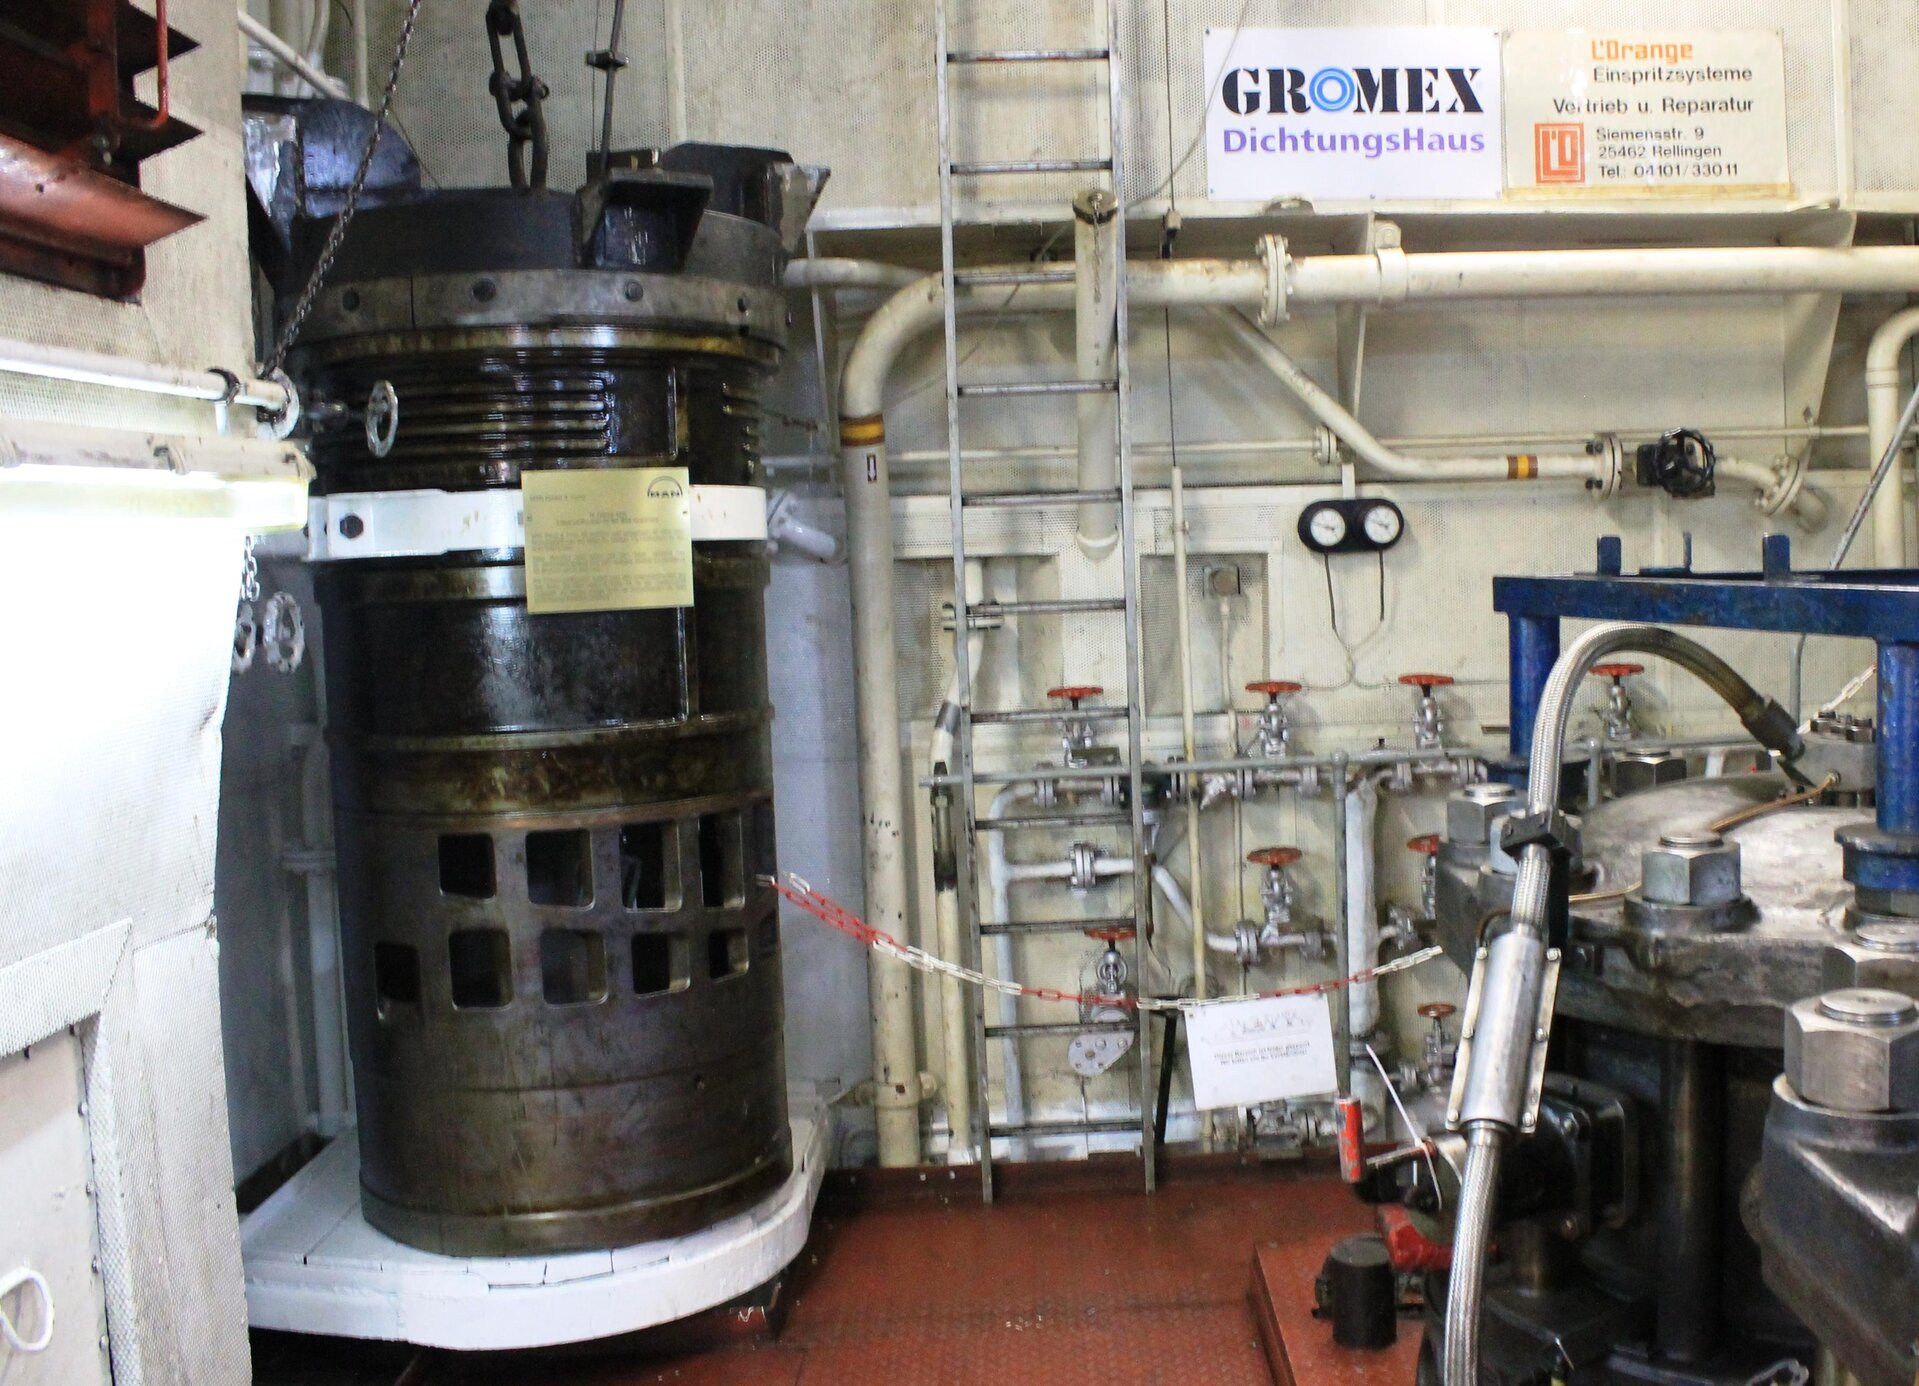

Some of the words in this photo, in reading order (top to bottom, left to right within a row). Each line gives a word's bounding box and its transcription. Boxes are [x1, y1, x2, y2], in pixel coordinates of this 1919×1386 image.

[1591, 39, 1693, 64] L'Orange
[1593, 65, 1753, 85] Einspritzsysteme
[1222, 67, 1484, 115] GROMEX
[1553, 97, 1628, 114] Vertrieb
[1662, 96, 1754, 116] Reparatur
[1223, 127, 1485, 158] DichtungsHaus
[1596, 127, 1687, 141] Siemensstr.
[1694, 127, 1705, 140] 9
[1652, 145, 1722, 160] Rellingen
